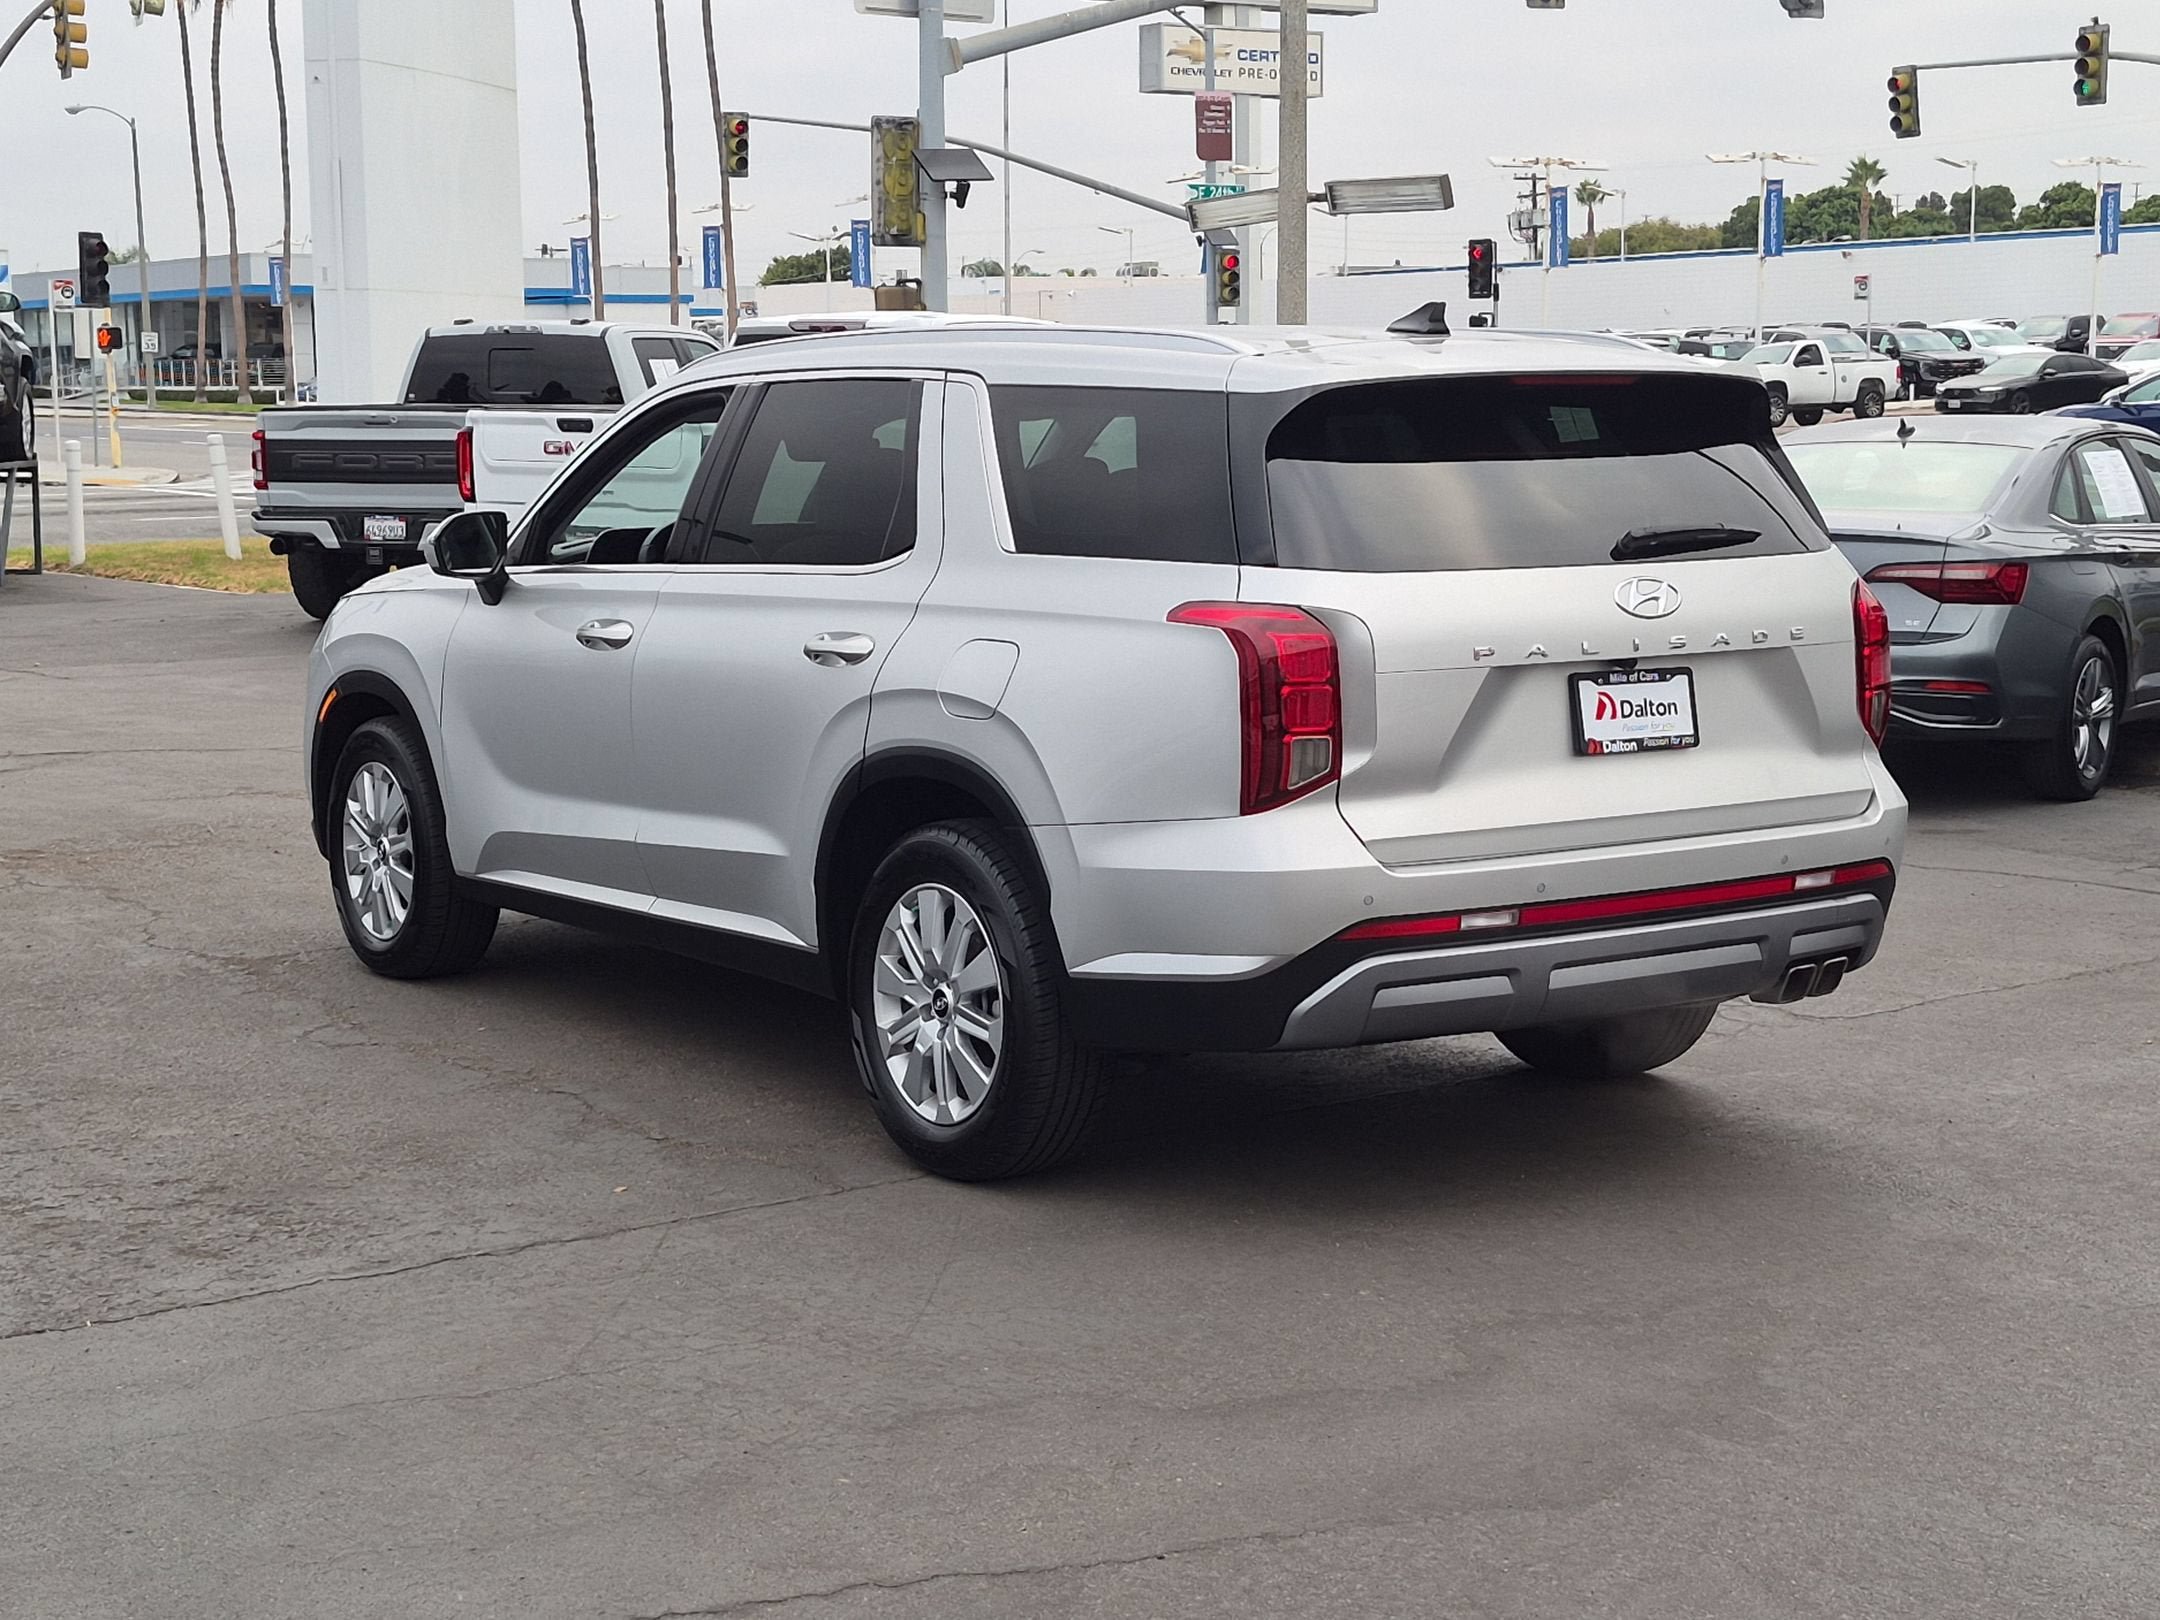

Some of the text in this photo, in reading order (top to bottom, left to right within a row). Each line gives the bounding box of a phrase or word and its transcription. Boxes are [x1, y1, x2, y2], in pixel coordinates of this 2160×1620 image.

[1238, 49, 1319, 64] CERTD
[1170, 66, 1233, 78] CHEVRLET
[1238, 67, 1318, 82] PRE-OD
[544, 440, 584, 456] GM
[1473, 626, 1805, 661] PALISADE
[1628, 672, 1638, 681] of
[1620, 698, 1679, 719] Dalton
[1602, 739, 1638, 754] Dalton
